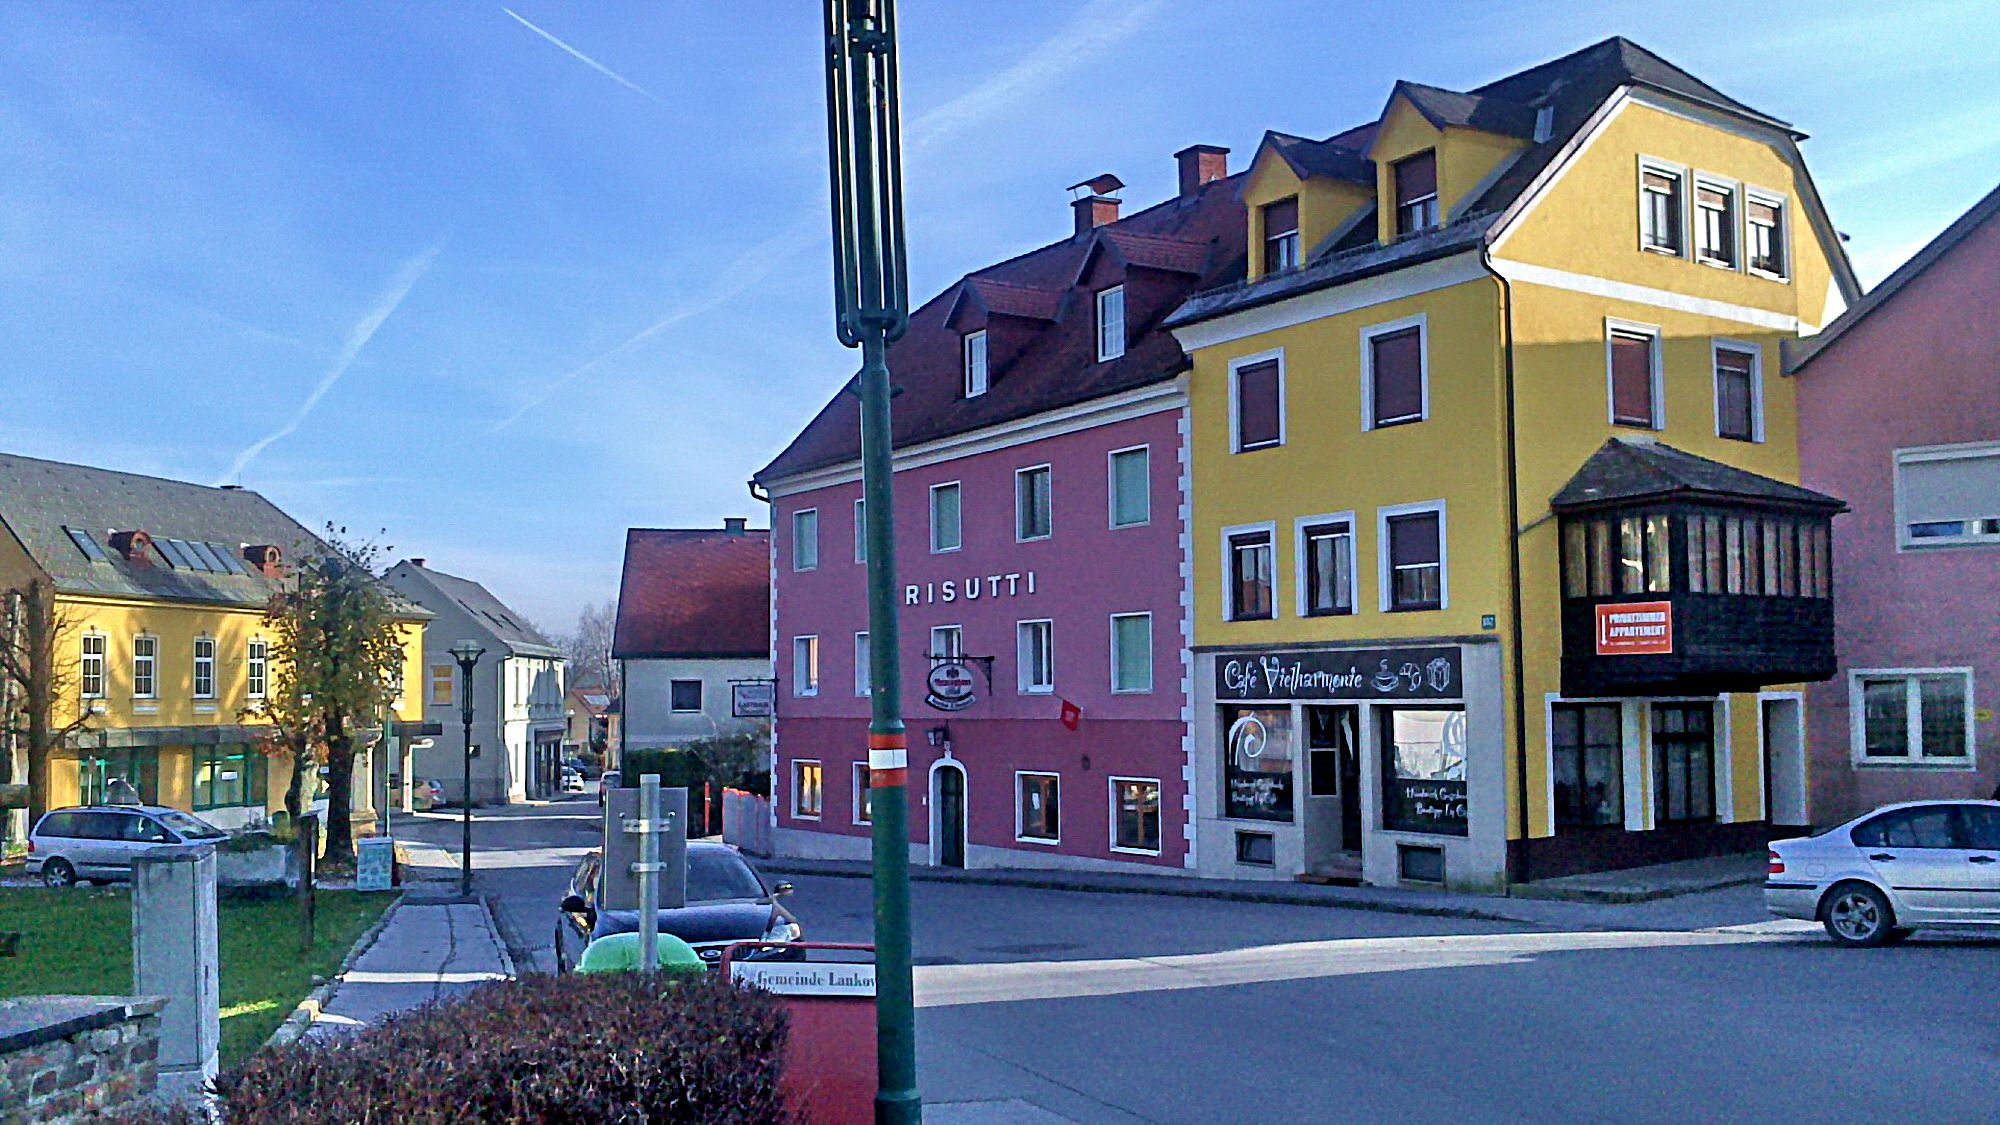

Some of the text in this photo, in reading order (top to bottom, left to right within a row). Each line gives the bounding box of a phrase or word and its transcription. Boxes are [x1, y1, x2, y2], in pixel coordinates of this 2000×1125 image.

[905, 571, 1036, 605] RISUTTI
[1224, 659, 1257, 697] Café
[757, 970, 825, 987] Gemeinde
